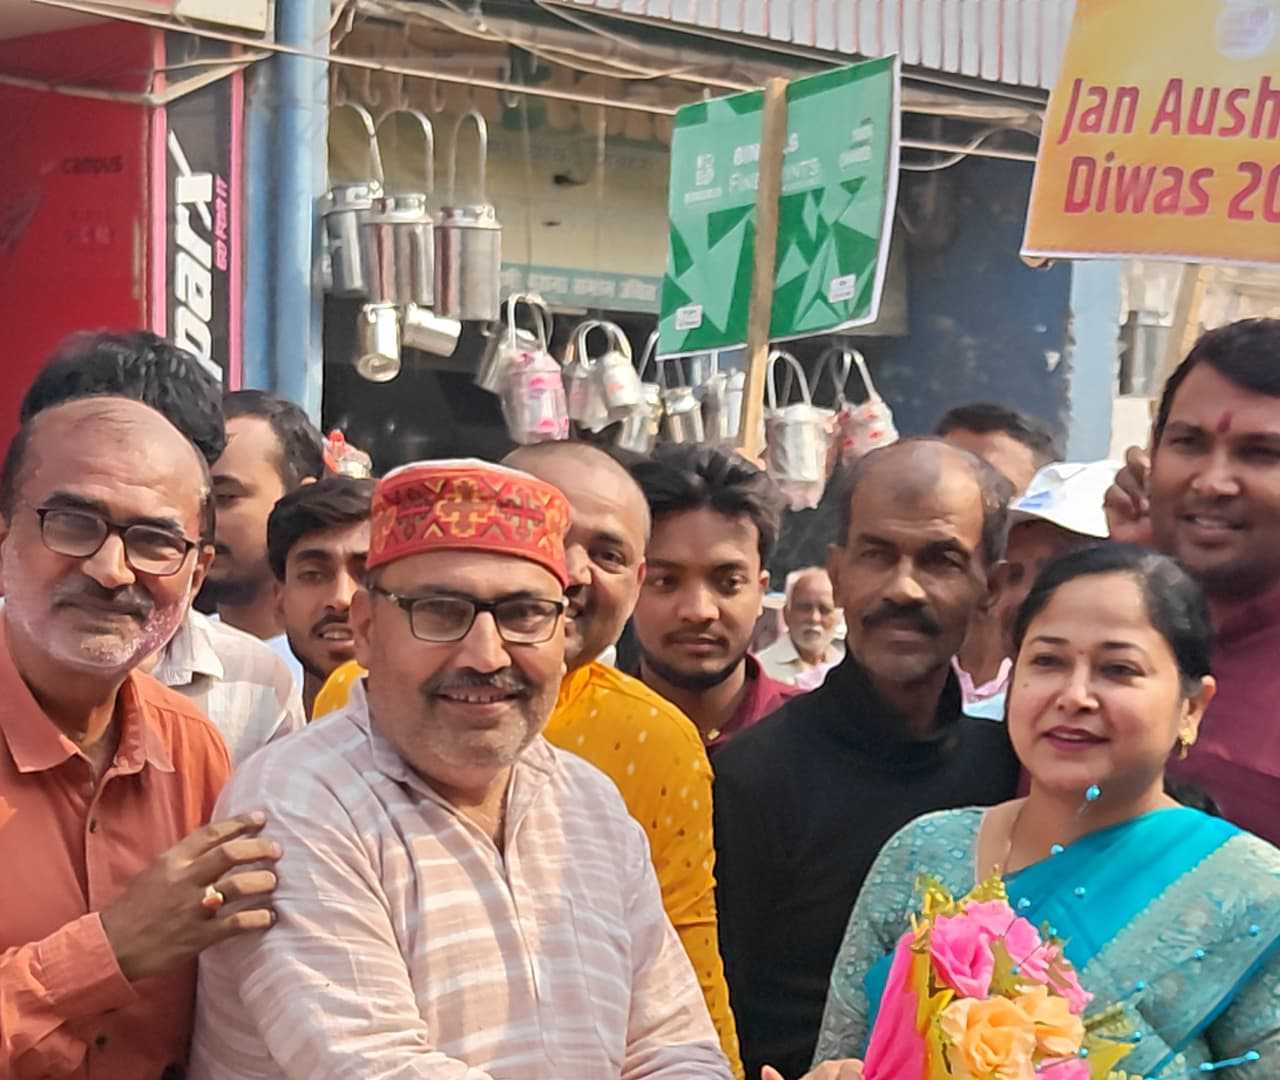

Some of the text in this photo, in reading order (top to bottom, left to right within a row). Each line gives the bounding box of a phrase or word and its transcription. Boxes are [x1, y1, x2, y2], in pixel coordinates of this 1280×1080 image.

[1056, 78, 1140, 145] Jan
[1063, 151, 1215, 217] Diwas
[169, 129, 224, 383] parx
